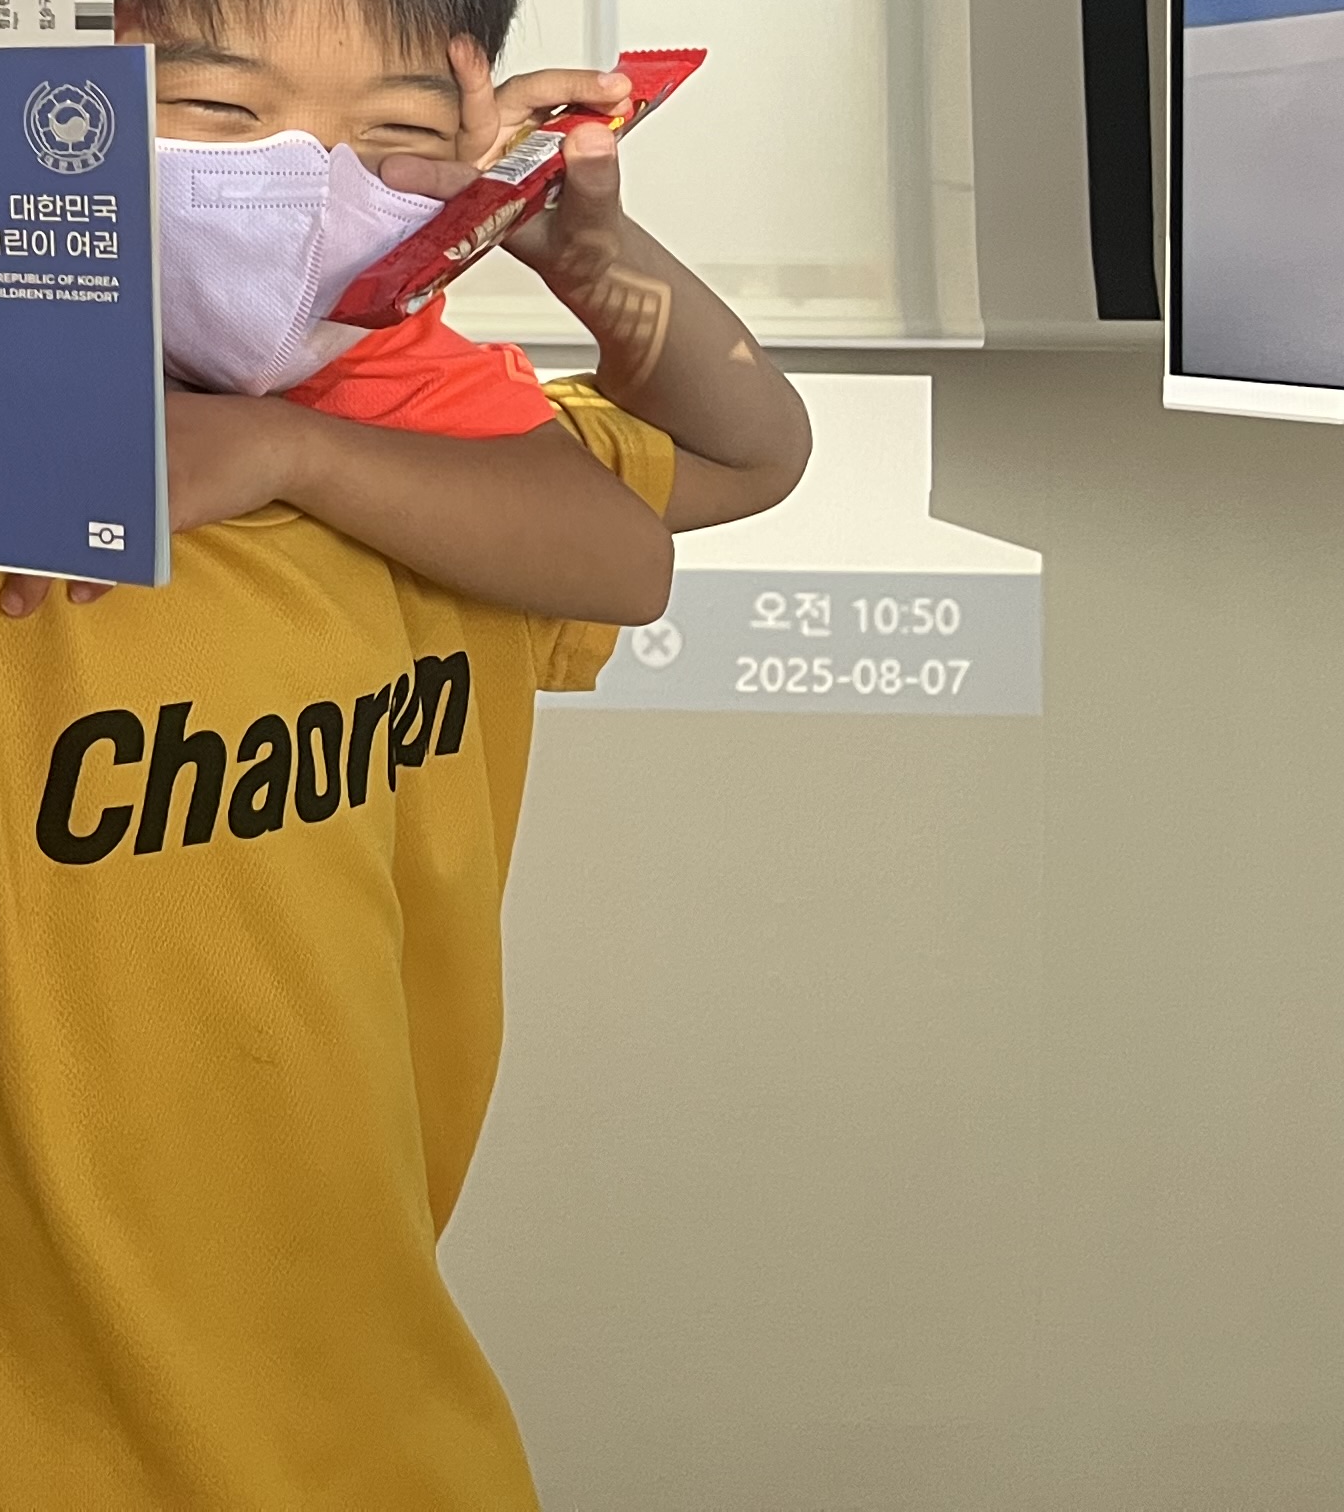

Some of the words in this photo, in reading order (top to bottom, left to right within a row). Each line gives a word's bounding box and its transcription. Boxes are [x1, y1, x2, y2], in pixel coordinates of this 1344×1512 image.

[9, 194, 118, 223] 대한민국
[66, 230, 119, 259] 여권
[77, 275, 119, 287] KOREA
[56, 289, 119, 303] PASSPORT
[749, 591, 833, 637] 오전
[852, 596, 961, 635] 10:50
[734, 656, 971, 696] 2025-08-07
